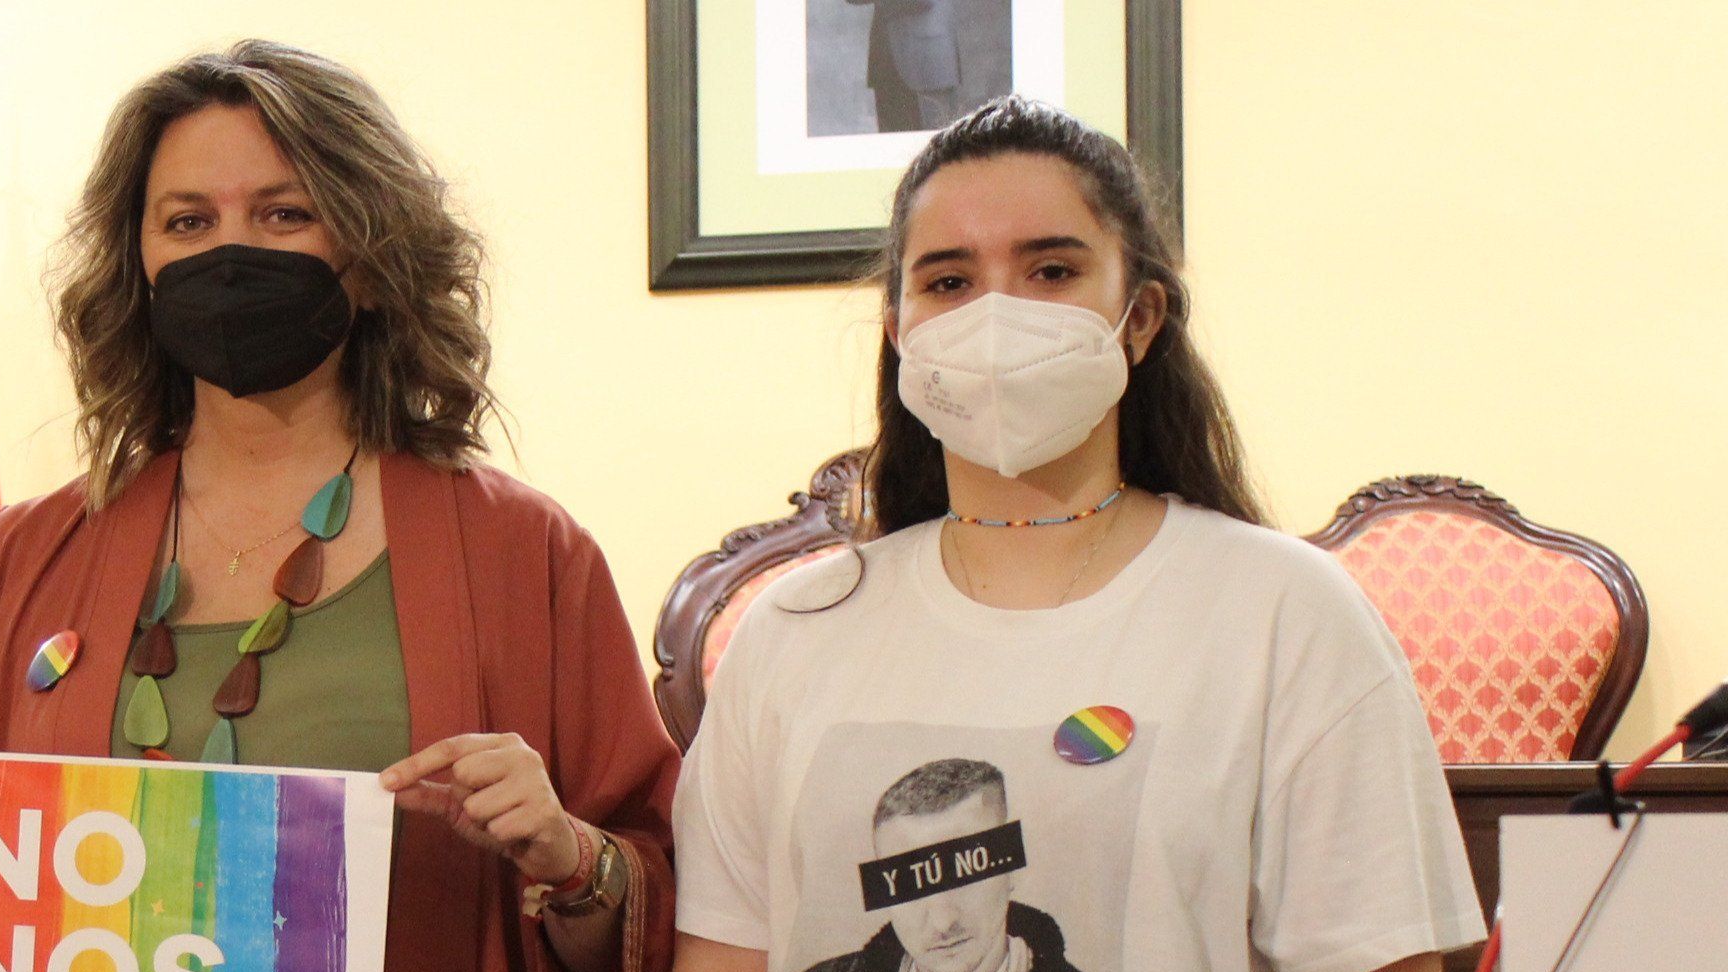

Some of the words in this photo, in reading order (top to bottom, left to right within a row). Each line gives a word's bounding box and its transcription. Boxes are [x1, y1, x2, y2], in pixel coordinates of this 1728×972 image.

[882, 868, 898, 896] Y
[910, 852, 943, 889] TÚ
[954, 846, 1013, 878] NO...
